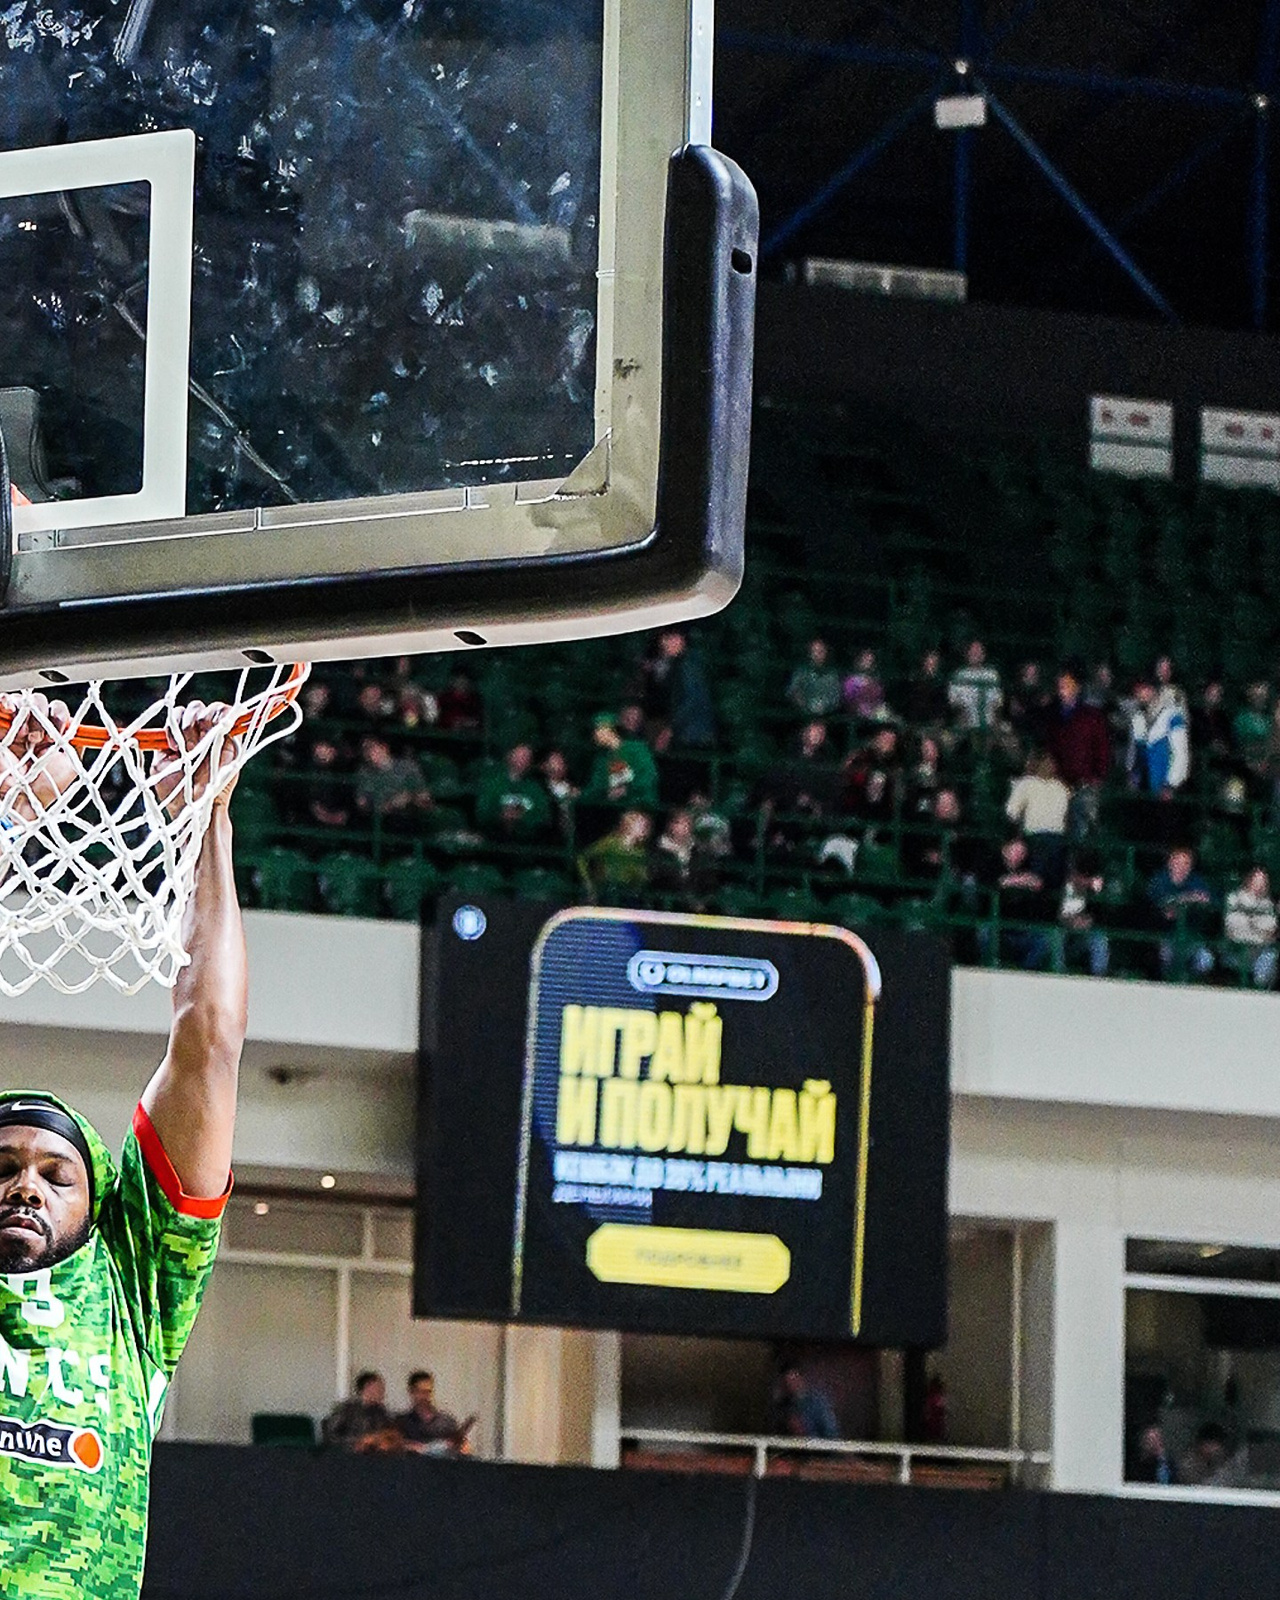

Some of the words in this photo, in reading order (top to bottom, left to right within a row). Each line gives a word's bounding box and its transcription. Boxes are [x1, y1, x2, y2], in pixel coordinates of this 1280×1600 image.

[560, 1002, 723, 1085] ИГРАЙ
[556, 1076, 598, 1146] И
[599, 1078, 837, 1164] ПОЛУЧАЙ
